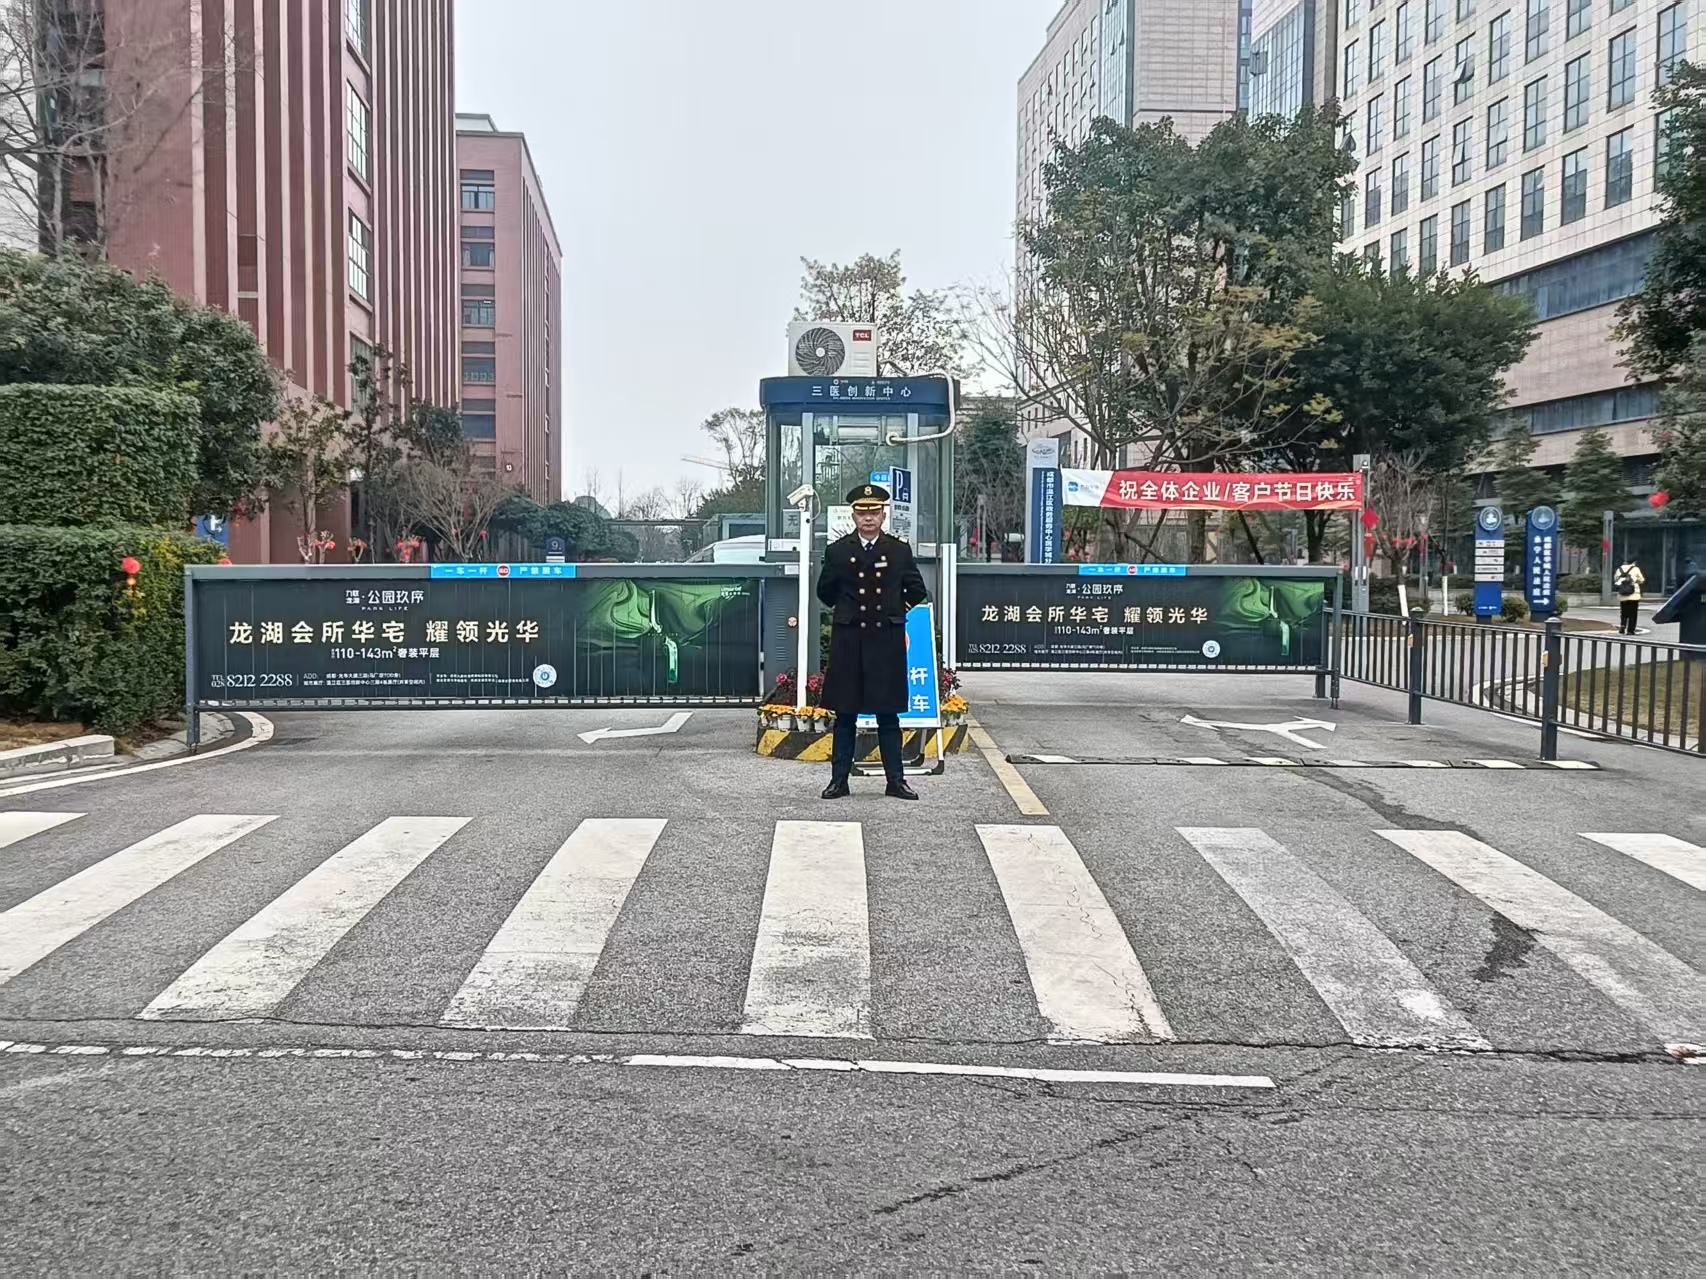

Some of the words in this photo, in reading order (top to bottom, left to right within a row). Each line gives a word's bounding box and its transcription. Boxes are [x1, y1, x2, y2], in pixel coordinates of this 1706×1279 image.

[812, 385, 911, 397] 三医创新中心
[895, 470, 903, 500] P
[1119, 480, 1354, 502] 祝全体企业/客户节日快乐
[981, 605, 1109, 623] 龙湖会所华宅
[1123, 606, 1208, 624] 耀领光华
[229, 620, 405, 644] 龙湖会所华宅
[426, 620, 539, 643] 耀领光华
[979, 643, 1001, 654] 8212
[1002, 643, 1027, 654] 2288
[226, 673, 256, 687] 8212
[260, 673, 293, 687] 2288
[912, 693, 930, 713] 车
